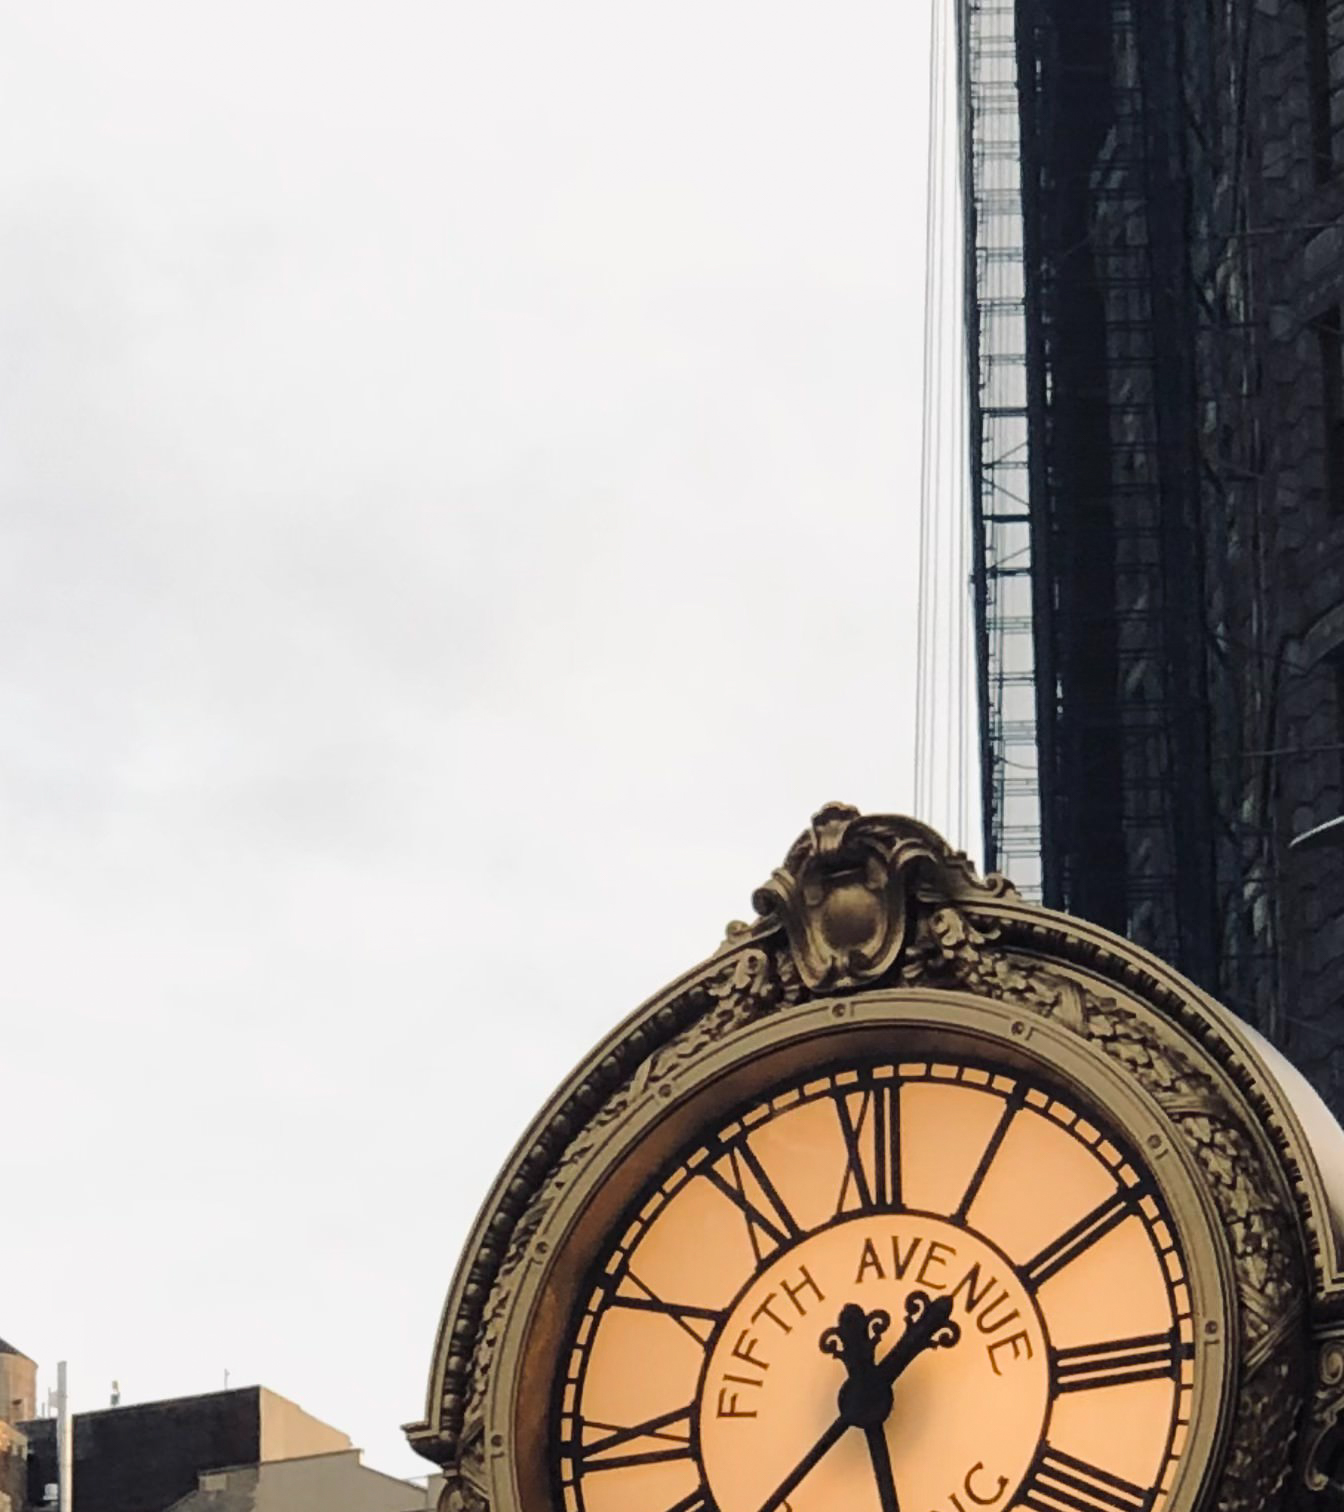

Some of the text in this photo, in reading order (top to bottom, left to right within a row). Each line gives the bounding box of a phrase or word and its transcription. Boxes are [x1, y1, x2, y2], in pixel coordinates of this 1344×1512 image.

[834, 1083, 906, 1216] XII
[717, 1236, 1033, 1418] FIFTH AVENUE
[1048, 1329, 1182, 1399] III
